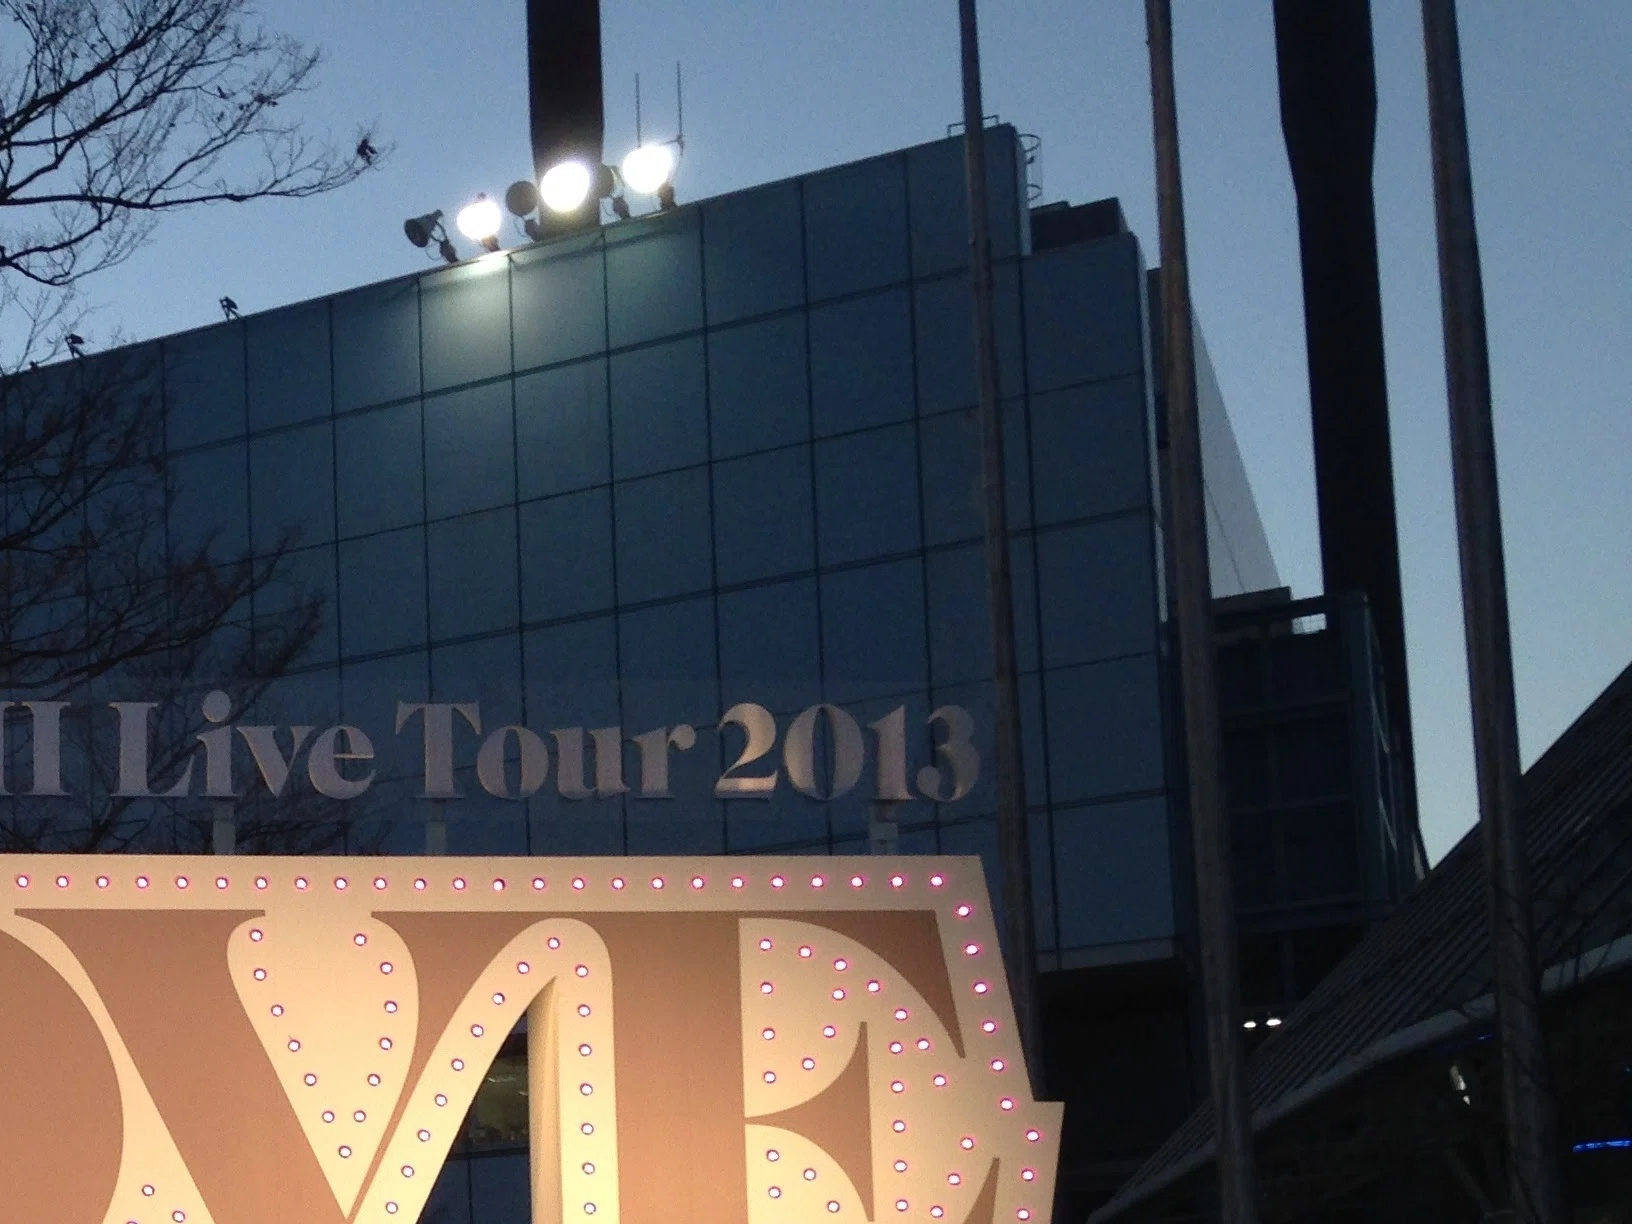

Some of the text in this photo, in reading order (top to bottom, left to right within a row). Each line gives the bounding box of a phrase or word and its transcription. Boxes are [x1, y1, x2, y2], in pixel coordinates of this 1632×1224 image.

[109, 689, 376, 799] Live
[395, 701, 697, 800] Tour
[714, 703, 980, 802] 2013
